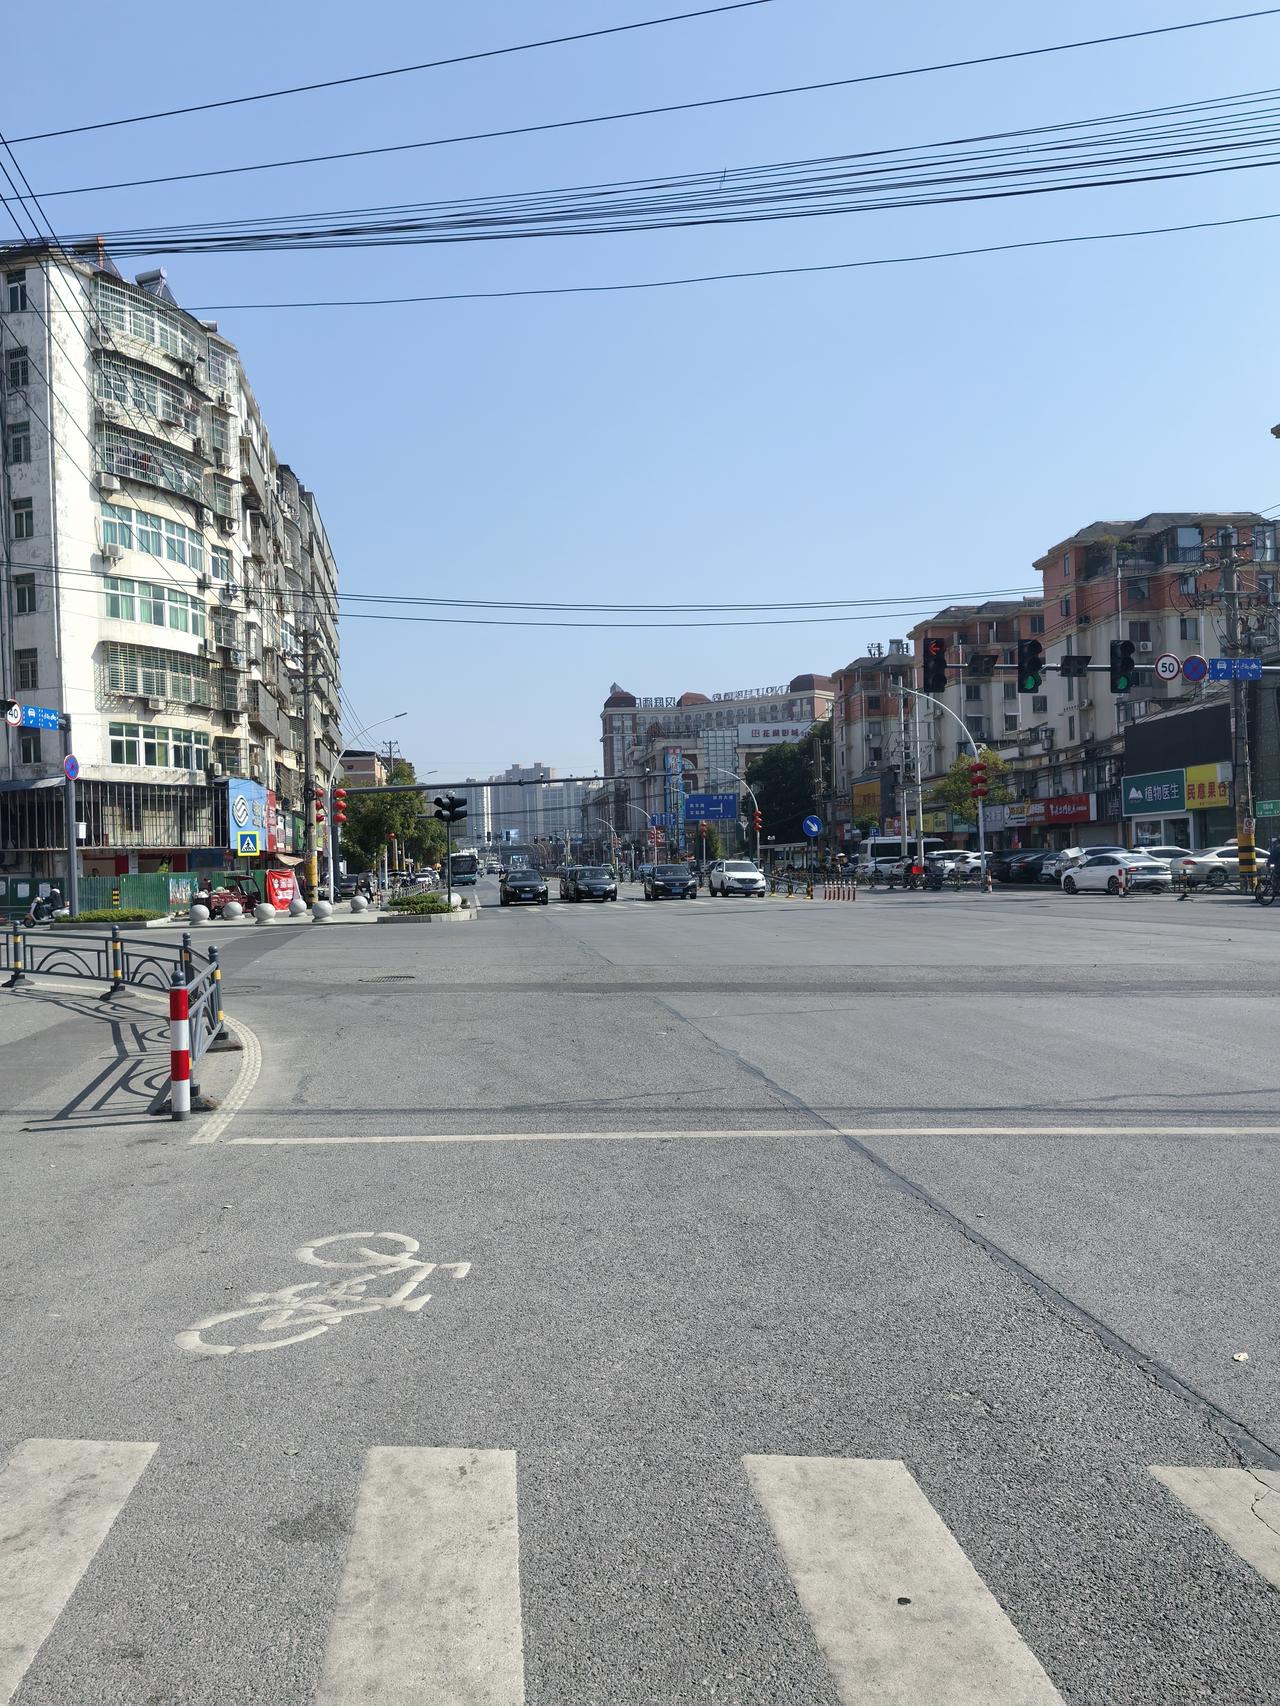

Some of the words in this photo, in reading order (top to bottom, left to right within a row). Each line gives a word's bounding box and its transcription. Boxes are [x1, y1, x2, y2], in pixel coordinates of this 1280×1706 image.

[1161, 662, 1175, 673] 50
[8, 708, 18, 719] 40
[1144, 783, 1179, 802] 植物医生
